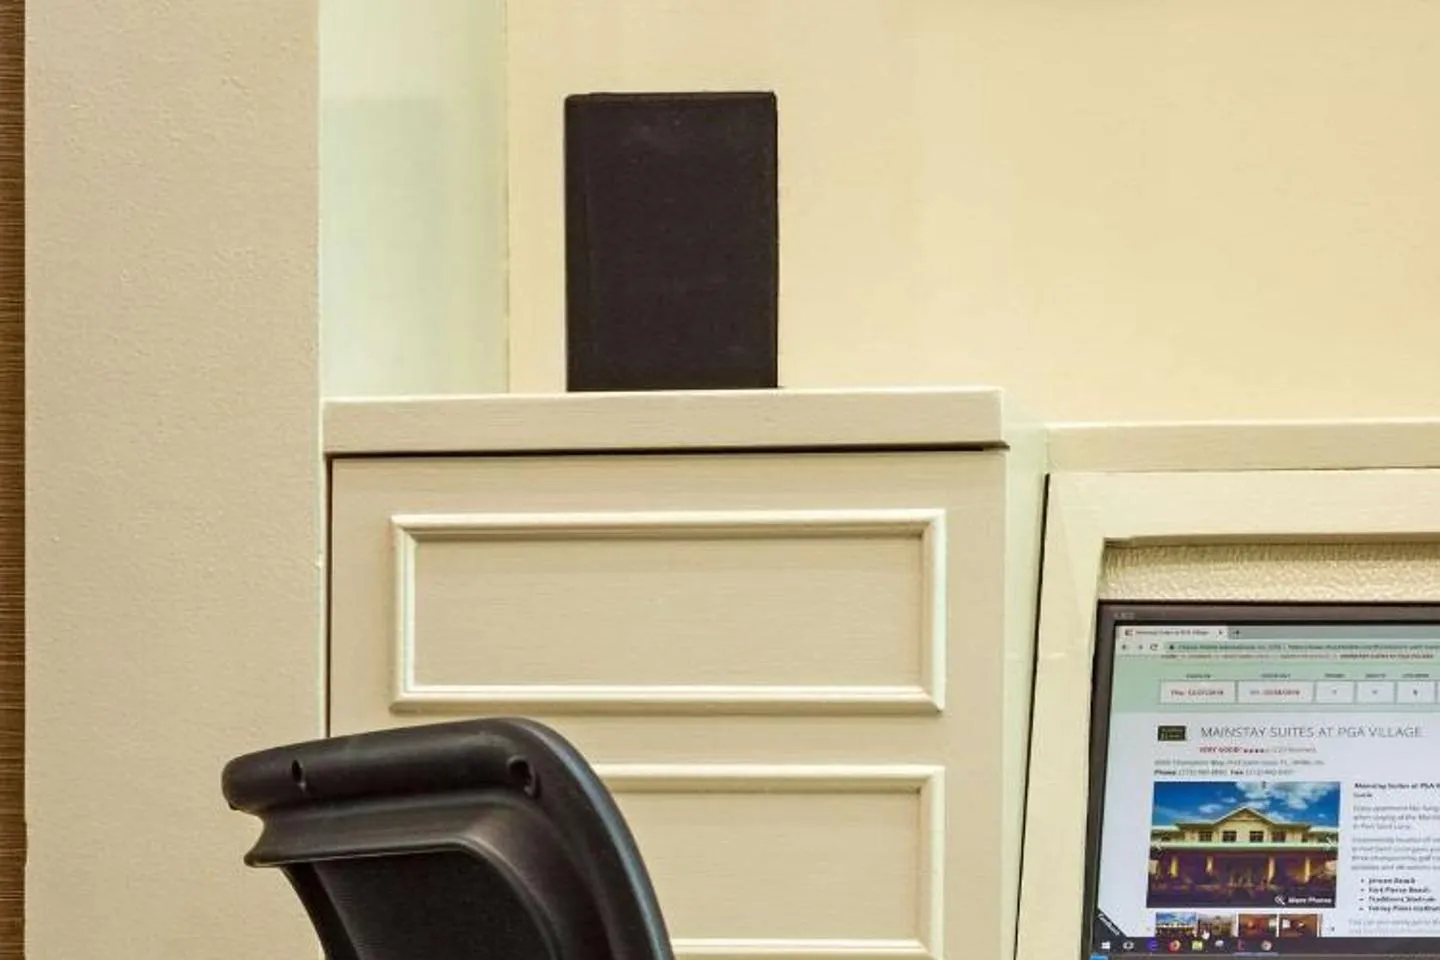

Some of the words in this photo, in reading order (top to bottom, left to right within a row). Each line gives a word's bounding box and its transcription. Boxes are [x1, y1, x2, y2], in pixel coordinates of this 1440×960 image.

[1200, 726, 1266, 738] MAINSTAY
[1270, 726, 1314, 738] SUITES
[1317, 727, 1333, 738] AT
[1339, 727, 1366, 738] PGA
[1369, 727, 1422, 738] VILLAGE
